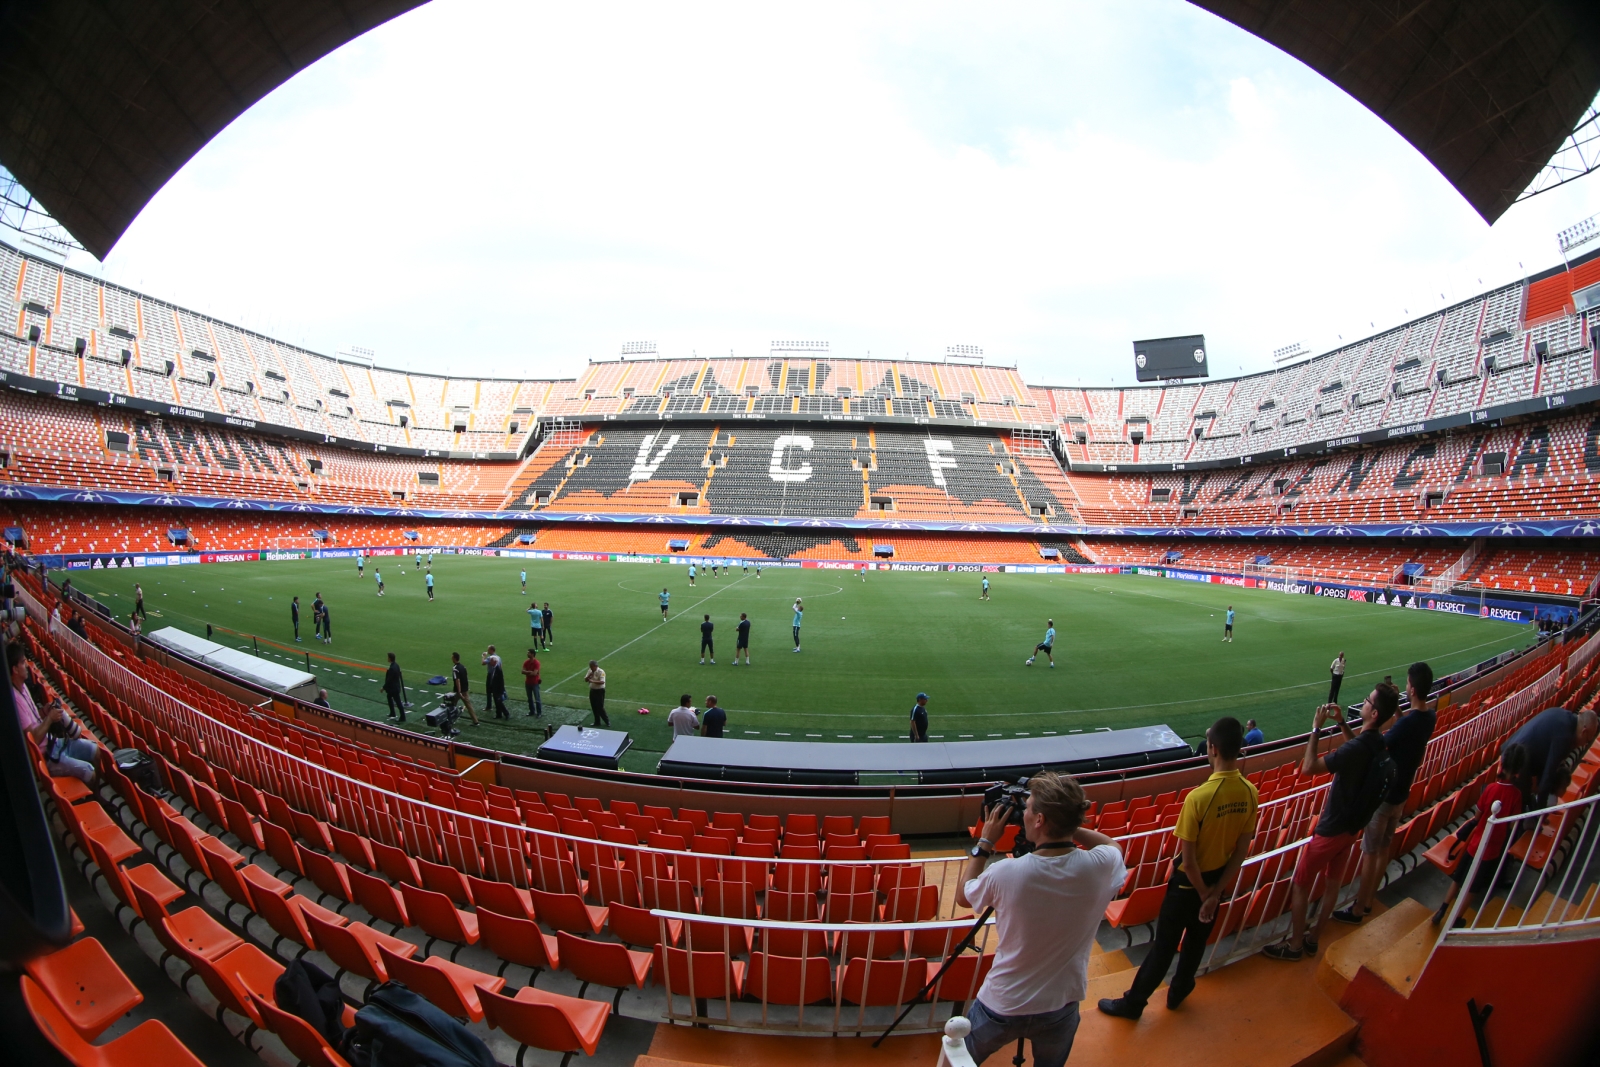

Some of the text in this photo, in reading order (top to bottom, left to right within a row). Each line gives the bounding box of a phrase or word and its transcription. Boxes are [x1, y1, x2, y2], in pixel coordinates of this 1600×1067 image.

[66, 387, 77, 396] 1942
[116, 396, 127, 405] 1944
[1552, 396, 1565, 407] 2004
[185, 410, 205, 420] MESTALLA
[1475, 411, 1488, 421] 2004
[1341, 436, 1360, 446] MESTALLA
[216, 554, 244, 562] NISSAN
[266, 552, 299, 561] Heineken
[824, 562, 854, 570] UniCredit
[891, 564, 939, 572] MasterCard
[958, 564, 981, 573] pepsi
[1138, 568, 1158, 578] Heineken
[1176, 572, 1198, 581] PlayStation
[1224, 576, 1245, 586] UniCredit
[1267, 580, 1307, 594] MasterCard
[1324, 588, 1347, 599] pepsi
[1436, 602, 1466, 614] RESPECT
[1490, 608, 1522, 622] RESPECT
